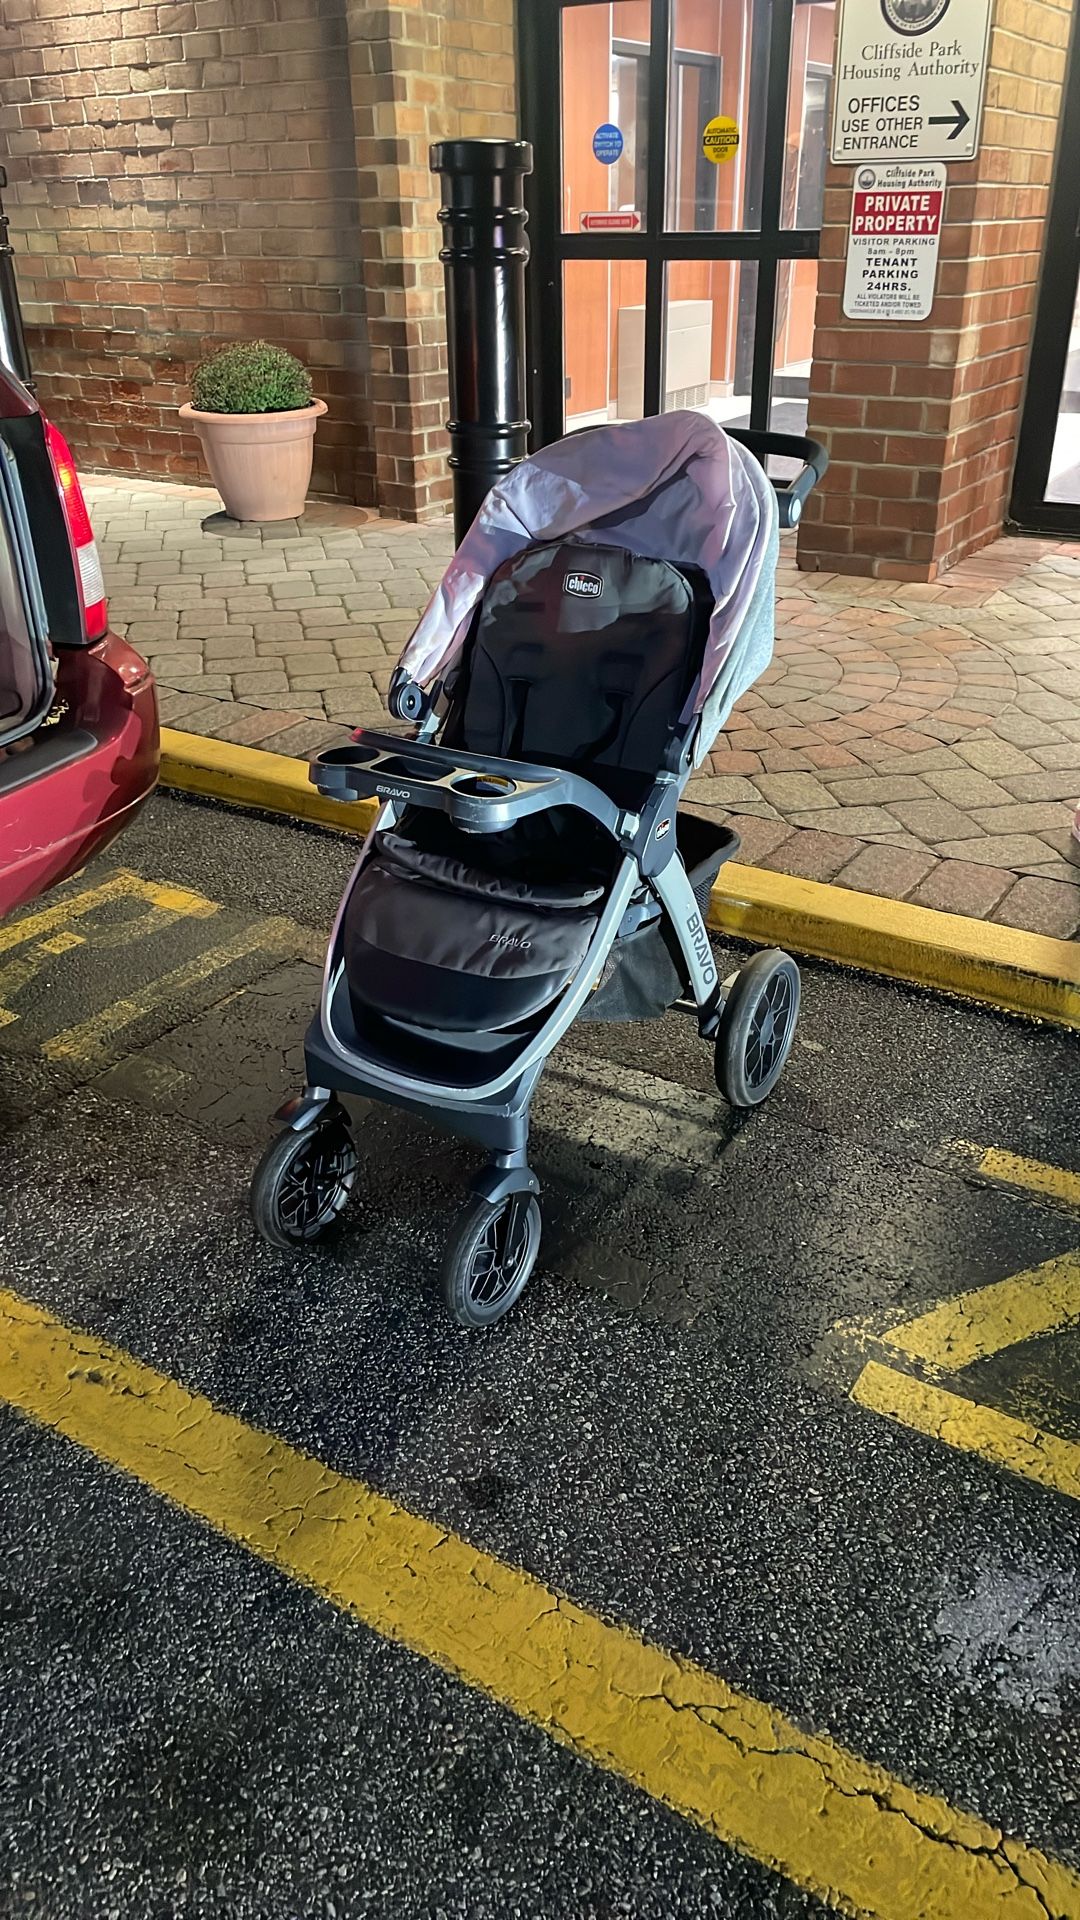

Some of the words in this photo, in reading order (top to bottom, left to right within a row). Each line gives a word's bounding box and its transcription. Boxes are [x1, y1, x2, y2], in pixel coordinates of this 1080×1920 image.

[861, 42, 923, 61] Cliffside
[929, 40, 962, 57] Park
[843, 63, 901, 81] Housing
[907, 59, 979, 77] Authority
[848, 95, 920, 114] OFFICES
[841, 118, 870, 133] USE
[875, 117, 923, 131] OTHER
[705, 136, 738, 145] CAUTION
[843, 135, 919, 150] ENTRANCE
[886, 168, 916, 178] Cliffside
[918, 167, 935, 177] Park
[877, 180, 906, 189] Housing
[908, 179, 942, 189] Authority
[864, 195, 931, 212] PRIVATE
[854, 214, 937, 232] PROPERTY
[853, 238, 890, 246] VISITOR
[893, 238, 936, 246] PARKING
[895, 248, 915, 256] 8pm
[866, 258, 918, 267] TENANT
[862, 270, 919, 279] PARKING
[867, 282, 911, 291] 24HRS.
[568, 576, 599, 594] chicco
[376, 784, 411, 799] BRAVO
[489, 934, 532, 949] BRAVO
[686, 911, 715, 985] BRAVO
